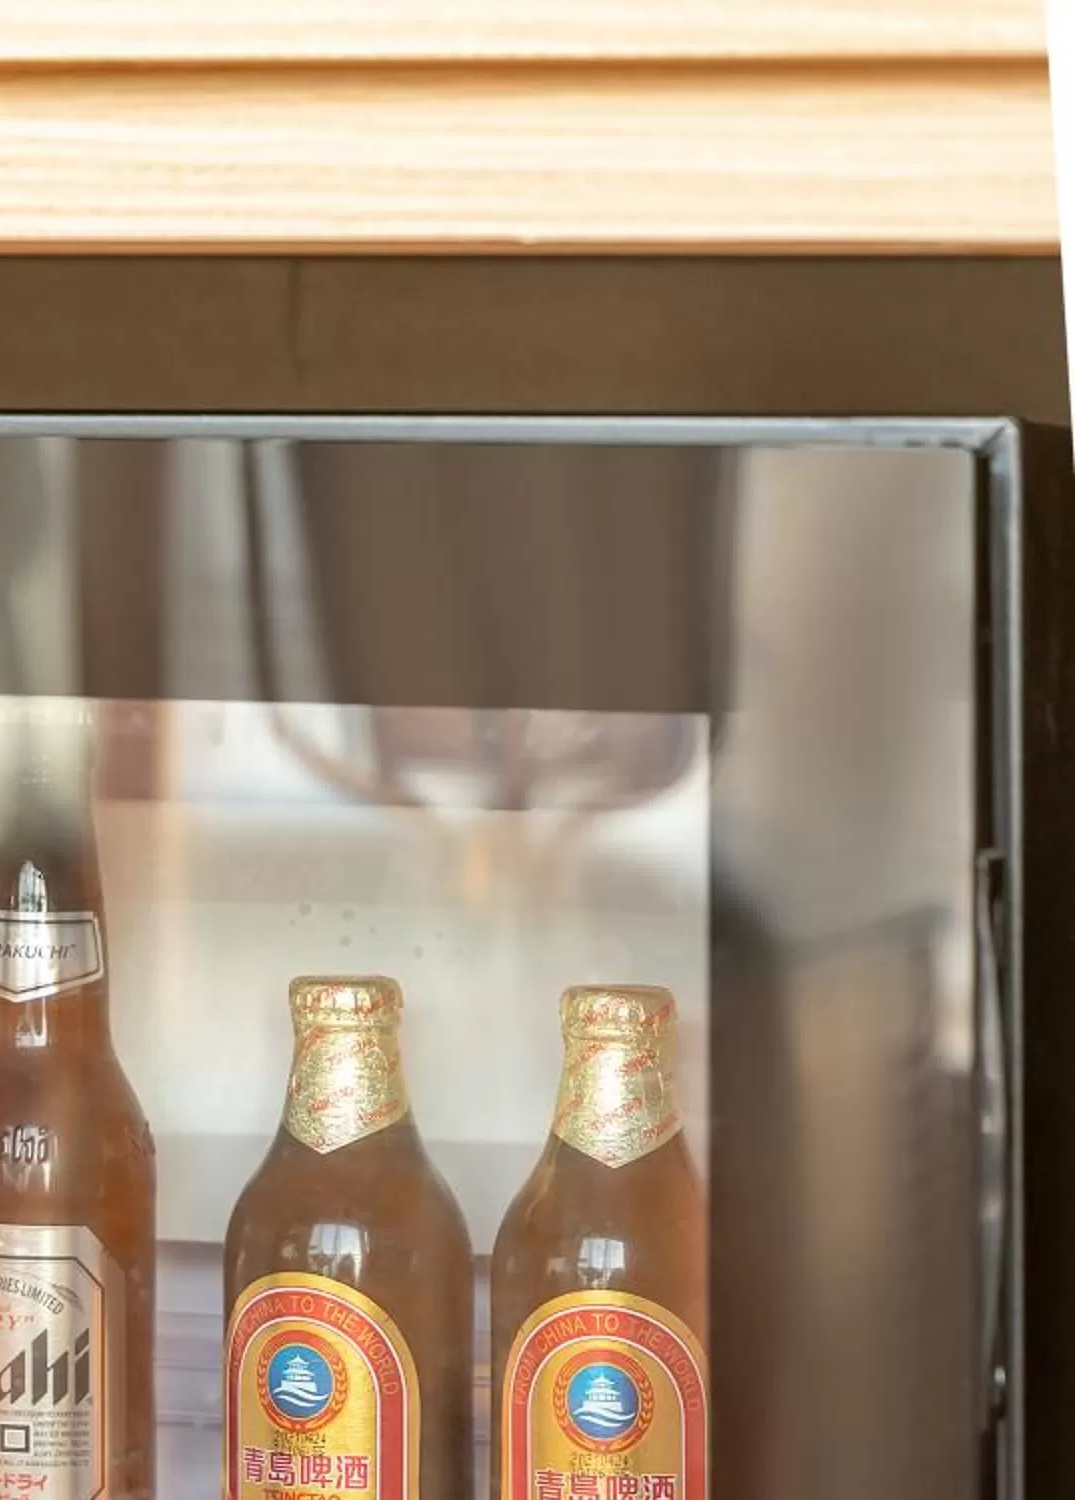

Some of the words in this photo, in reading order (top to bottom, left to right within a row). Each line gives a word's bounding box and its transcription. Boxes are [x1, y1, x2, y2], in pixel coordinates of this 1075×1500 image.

[20, 1282, 65, 1316] LIMITED
[289, 1295, 314, 1313] TO
[323, 1301, 360, 1335] THE
[355, 1326, 399, 1397] WORLD
[536, 1318, 588, 1353] CHINA
[591, 1312, 620, 1332] TO
